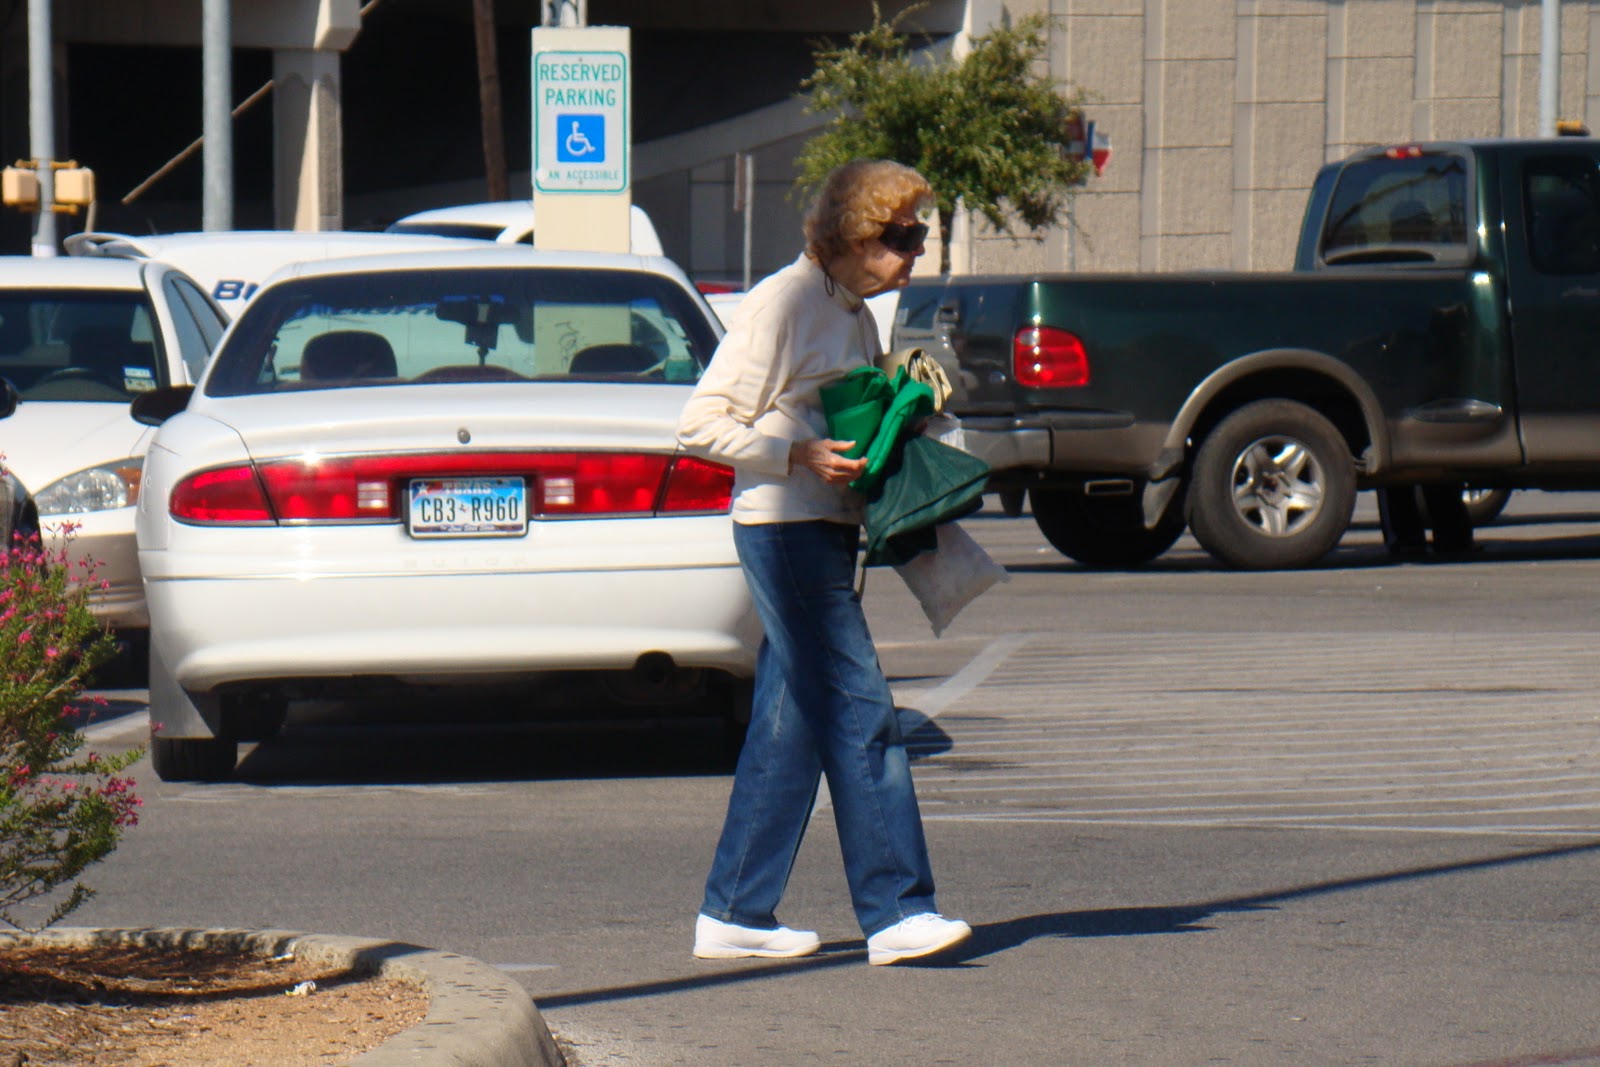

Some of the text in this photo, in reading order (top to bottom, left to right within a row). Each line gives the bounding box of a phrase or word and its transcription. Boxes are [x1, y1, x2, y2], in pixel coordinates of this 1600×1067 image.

[540, 64, 621, 81] RESERVED
[545, 88, 616, 106] PARKING
[545, 169, 618, 181] AN ACCESSIBLE
[442, 482, 492, 494] TEXAS
[421, 496, 518, 522] CB3 R960
